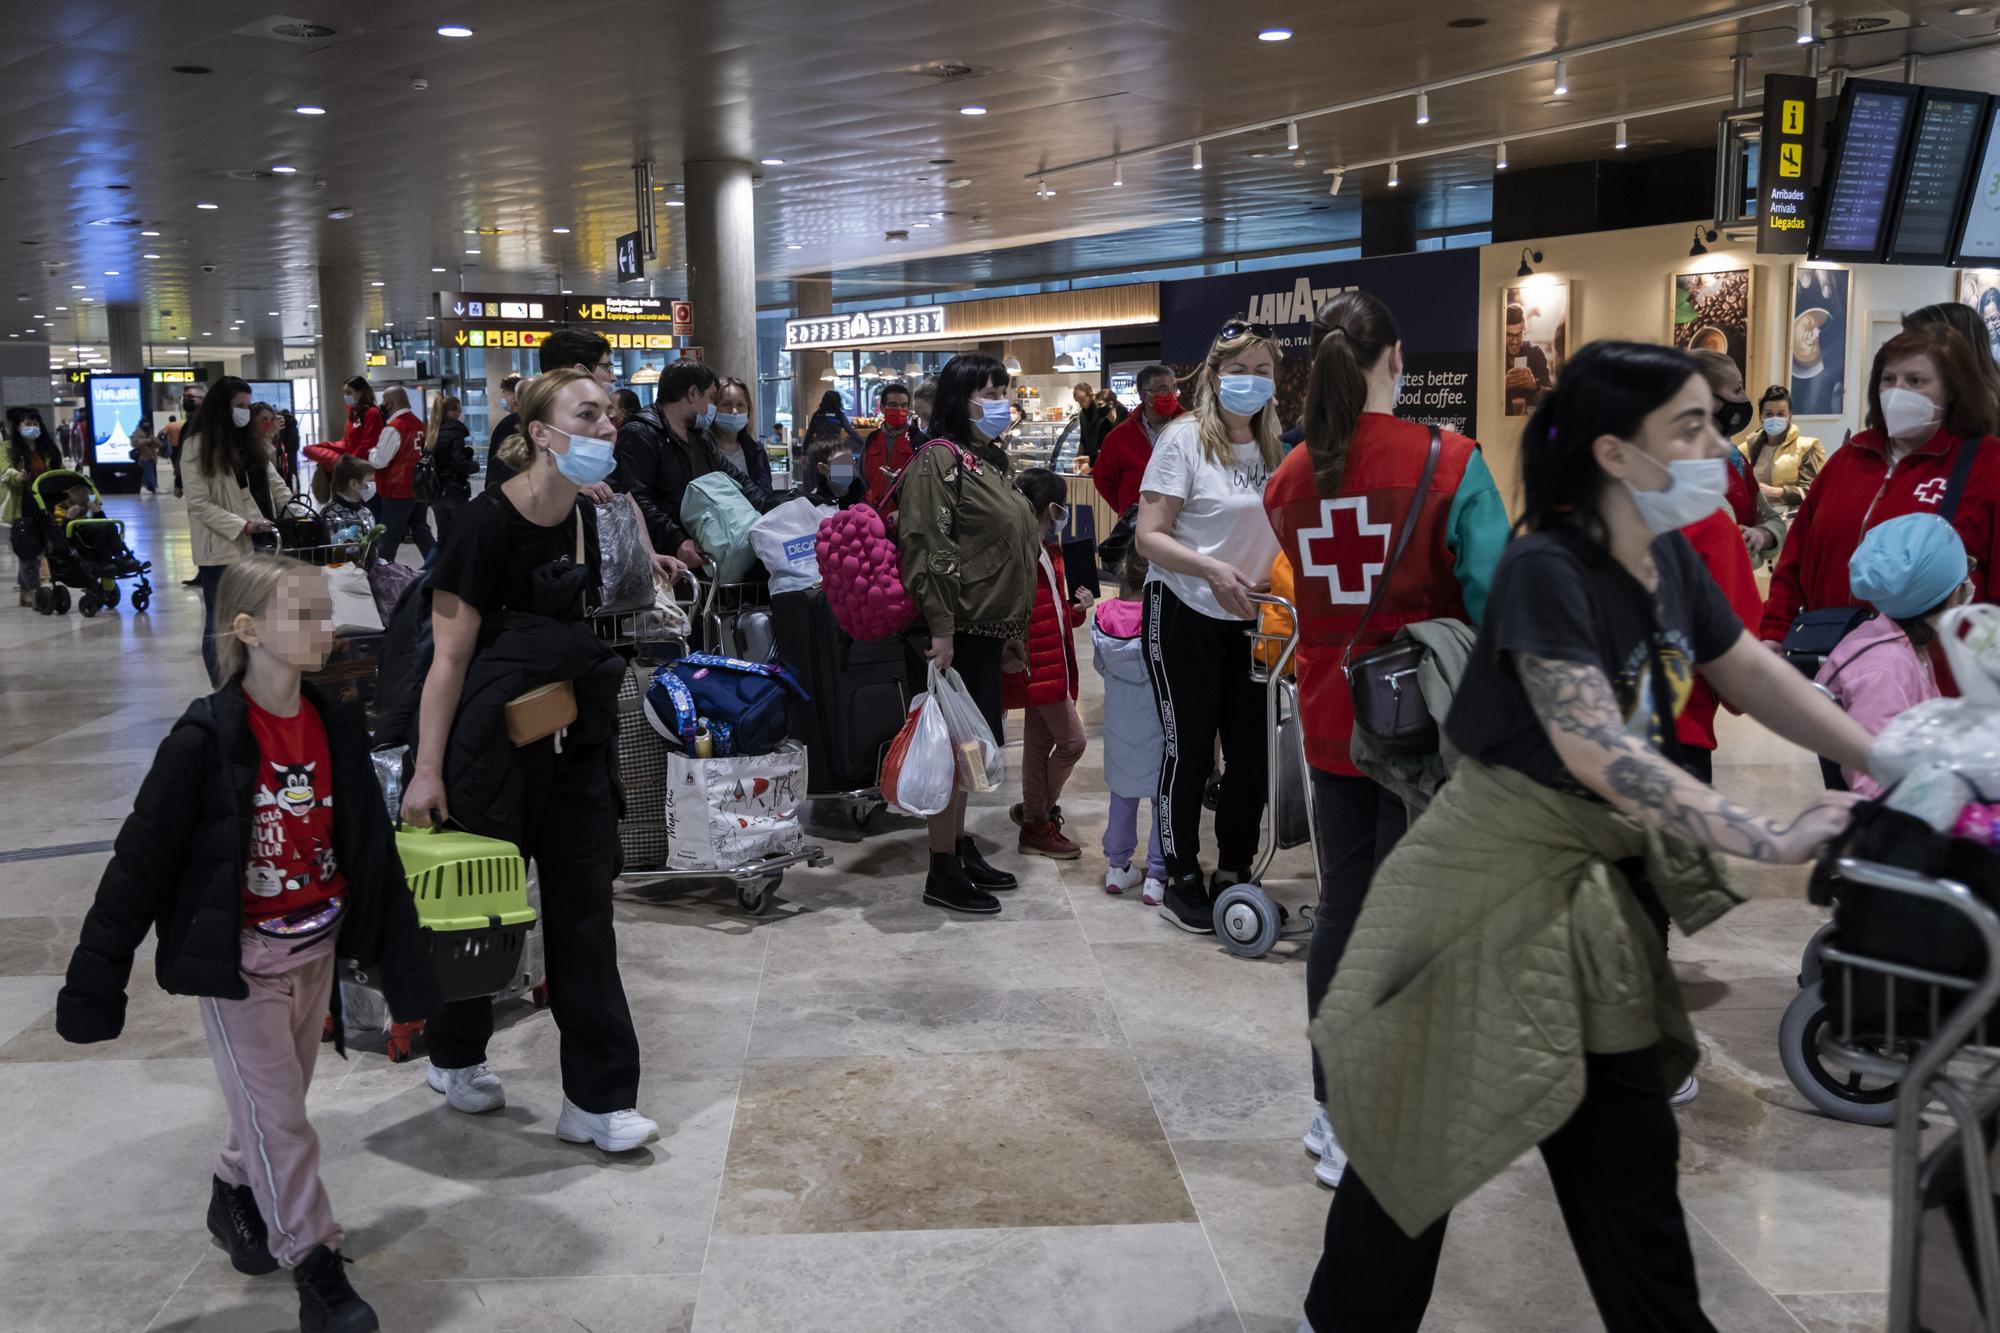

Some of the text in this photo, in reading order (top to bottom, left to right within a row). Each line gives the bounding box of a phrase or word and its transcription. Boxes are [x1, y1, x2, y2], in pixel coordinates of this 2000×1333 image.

[1770, 188, 1804, 201] Arribades
[1770, 202, 1797, 214] Arrivals
[1770, 215, 1805, 231] Llegadas
[1247, 277, 1359, 325] LAVAZ
[870, 312, 941, 337] BAKERY
[1427, 370, 1468, 386] better
[1424, 388, 1467, 408] coffee.
[1150, 594, 1161, 662] CHRISTIAN DIOR
[1162, 700, 1175, 742] CHRISTIAN
[1160, 795, 1173, 854] CHRISTIAN DIOR
